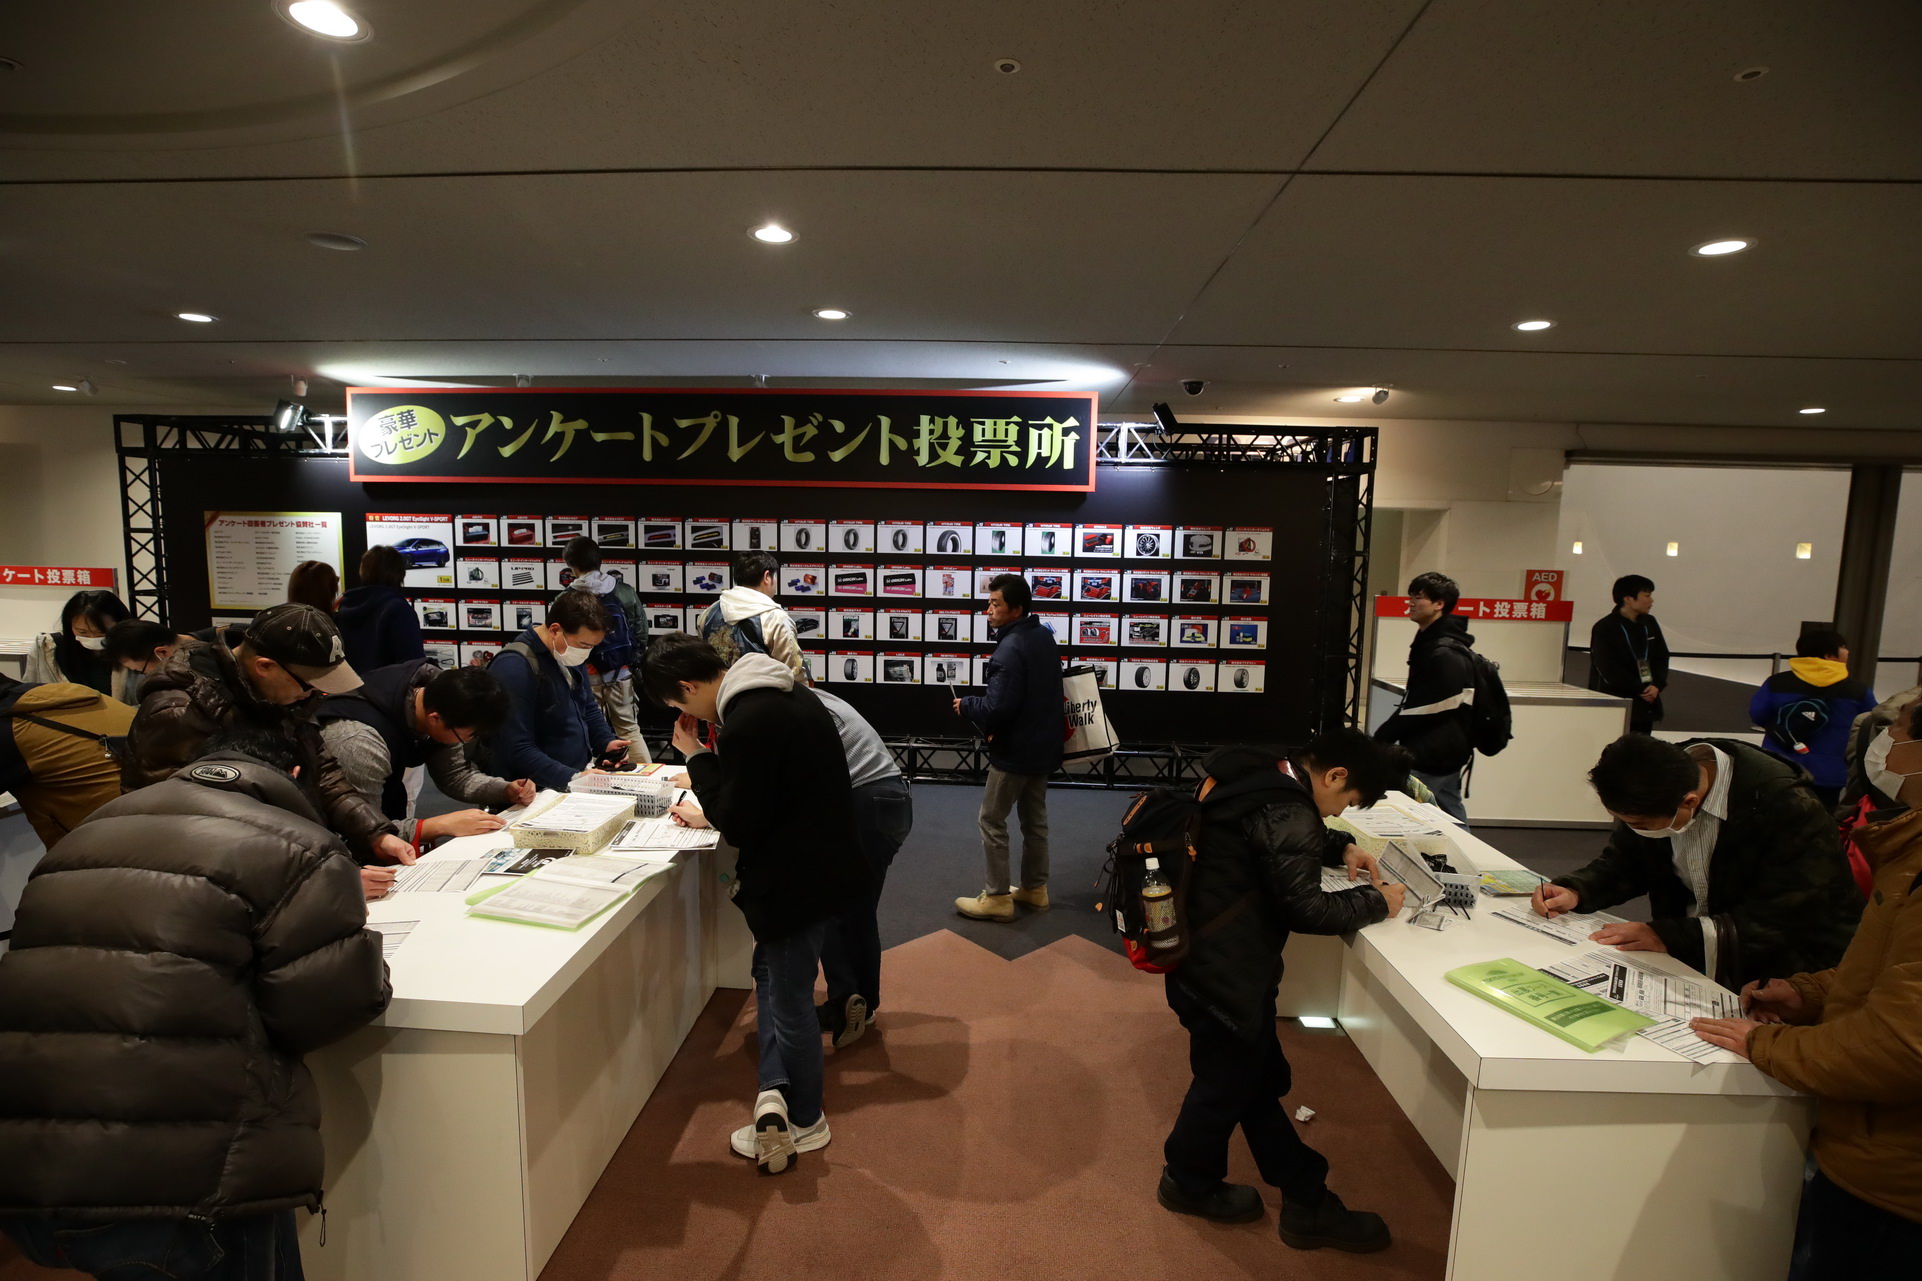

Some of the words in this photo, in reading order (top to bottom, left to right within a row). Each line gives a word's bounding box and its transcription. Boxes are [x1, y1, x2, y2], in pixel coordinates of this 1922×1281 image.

[378, 409, 418, 435] 豪華
[370, 428, 439, 458] プレゼント
[449, 409, 1080, 470] アンケートプレゼント投票所
[2, 568, 91, 585] ケート投票箱
[1532, 572, 1557, 582] AED
[1404, 600, 1546, 619] ート投票箱
[329, 635, 345, 663] A
[1063, 698, 1097, 715] Liberty
[1068, 712, 1094, 728] Walk
